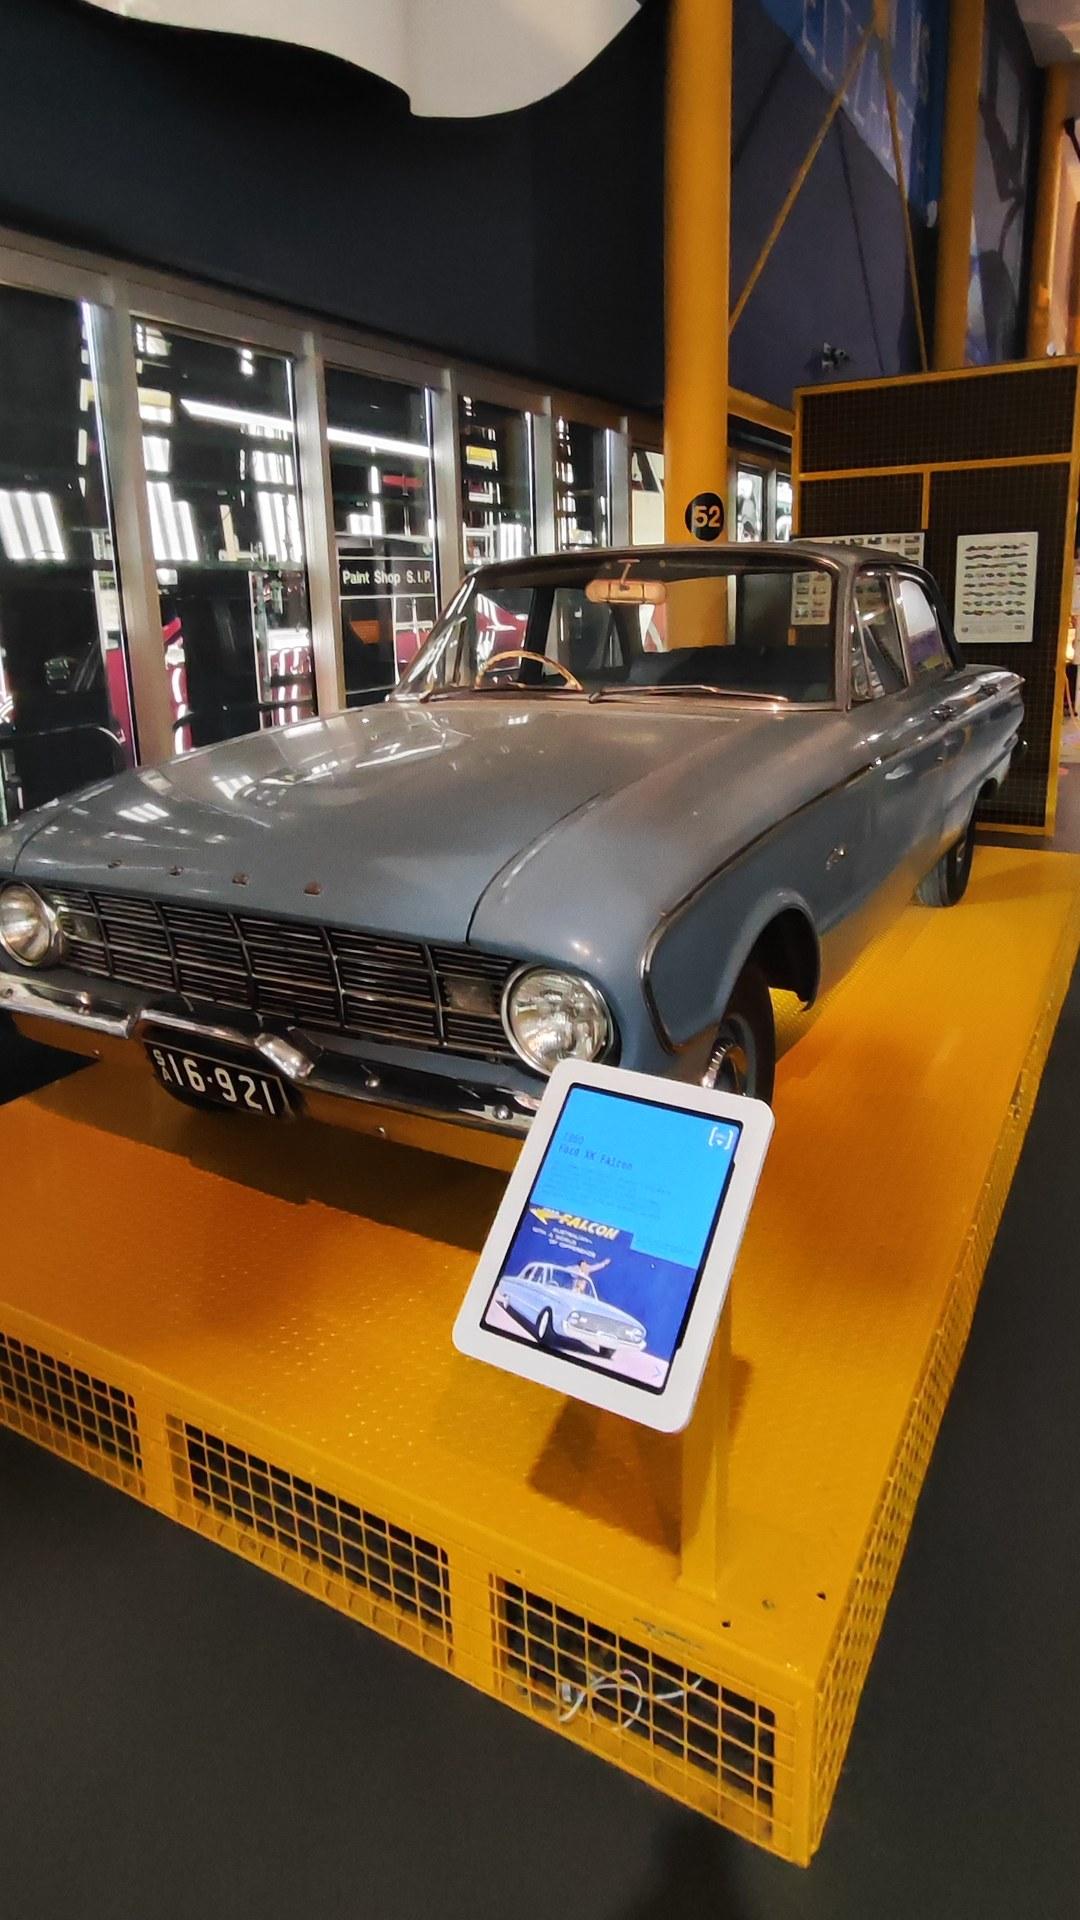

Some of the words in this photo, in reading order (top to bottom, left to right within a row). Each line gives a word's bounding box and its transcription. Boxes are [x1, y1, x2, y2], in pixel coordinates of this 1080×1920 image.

[695, 505, 720, 527] 52
[342, 570, 370, 584] Paint
[374, 570, 401, 586] Shop
[600, 1154, 633, 1169] Falcon
[559, 1213, 620, 1241] FALCON
